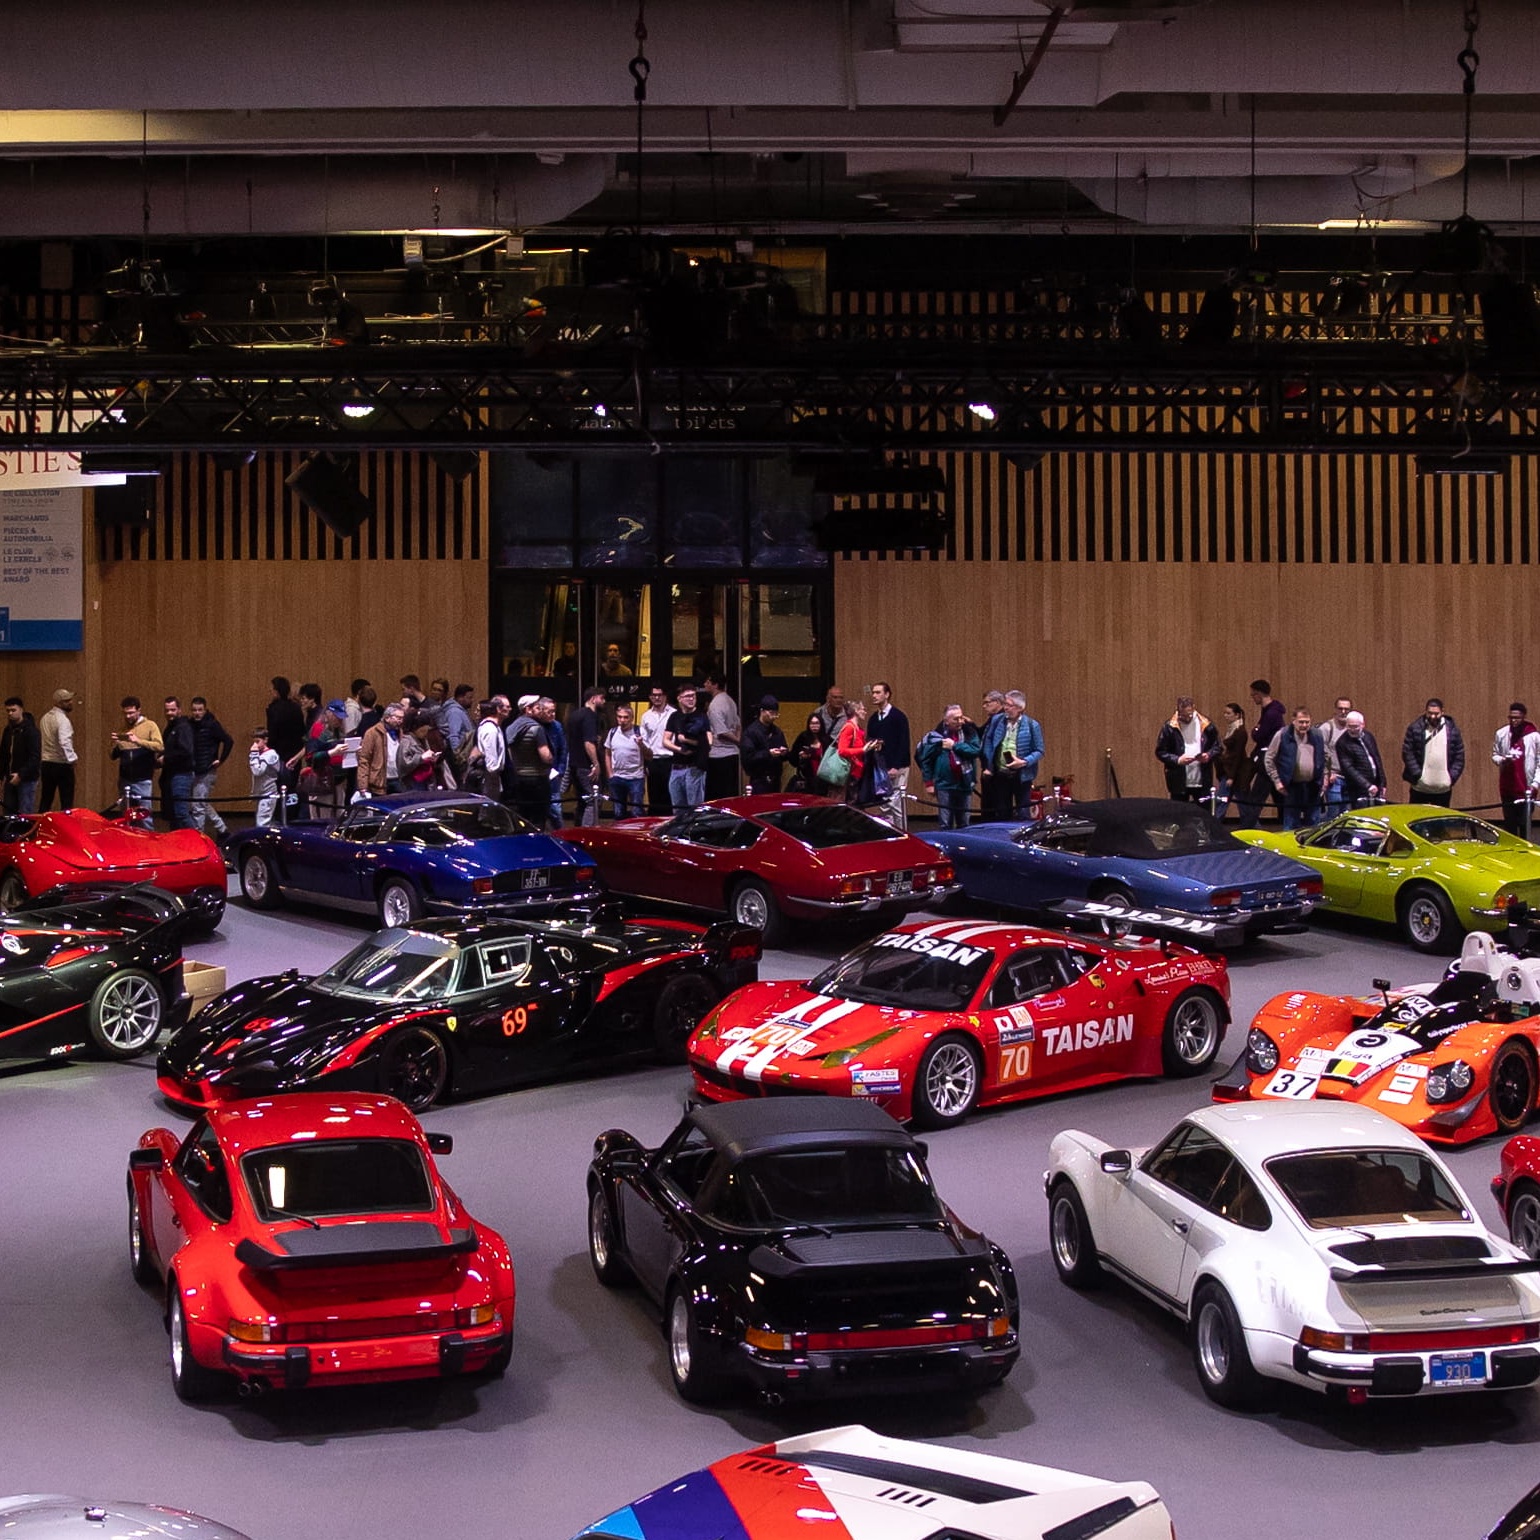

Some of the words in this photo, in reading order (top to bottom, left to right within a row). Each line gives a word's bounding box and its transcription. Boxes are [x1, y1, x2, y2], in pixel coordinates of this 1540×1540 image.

[873, 932, 988, 966] TAISAN
[502, 1007, 527, 1037] 69
[1041, 1013, 1134, 1057] TAISAN
[1001, 1045, 1030, 1079] 70
[1271, 1073, 1317, 1097] 37
[1445, 1363, 1472, 1380] 930
